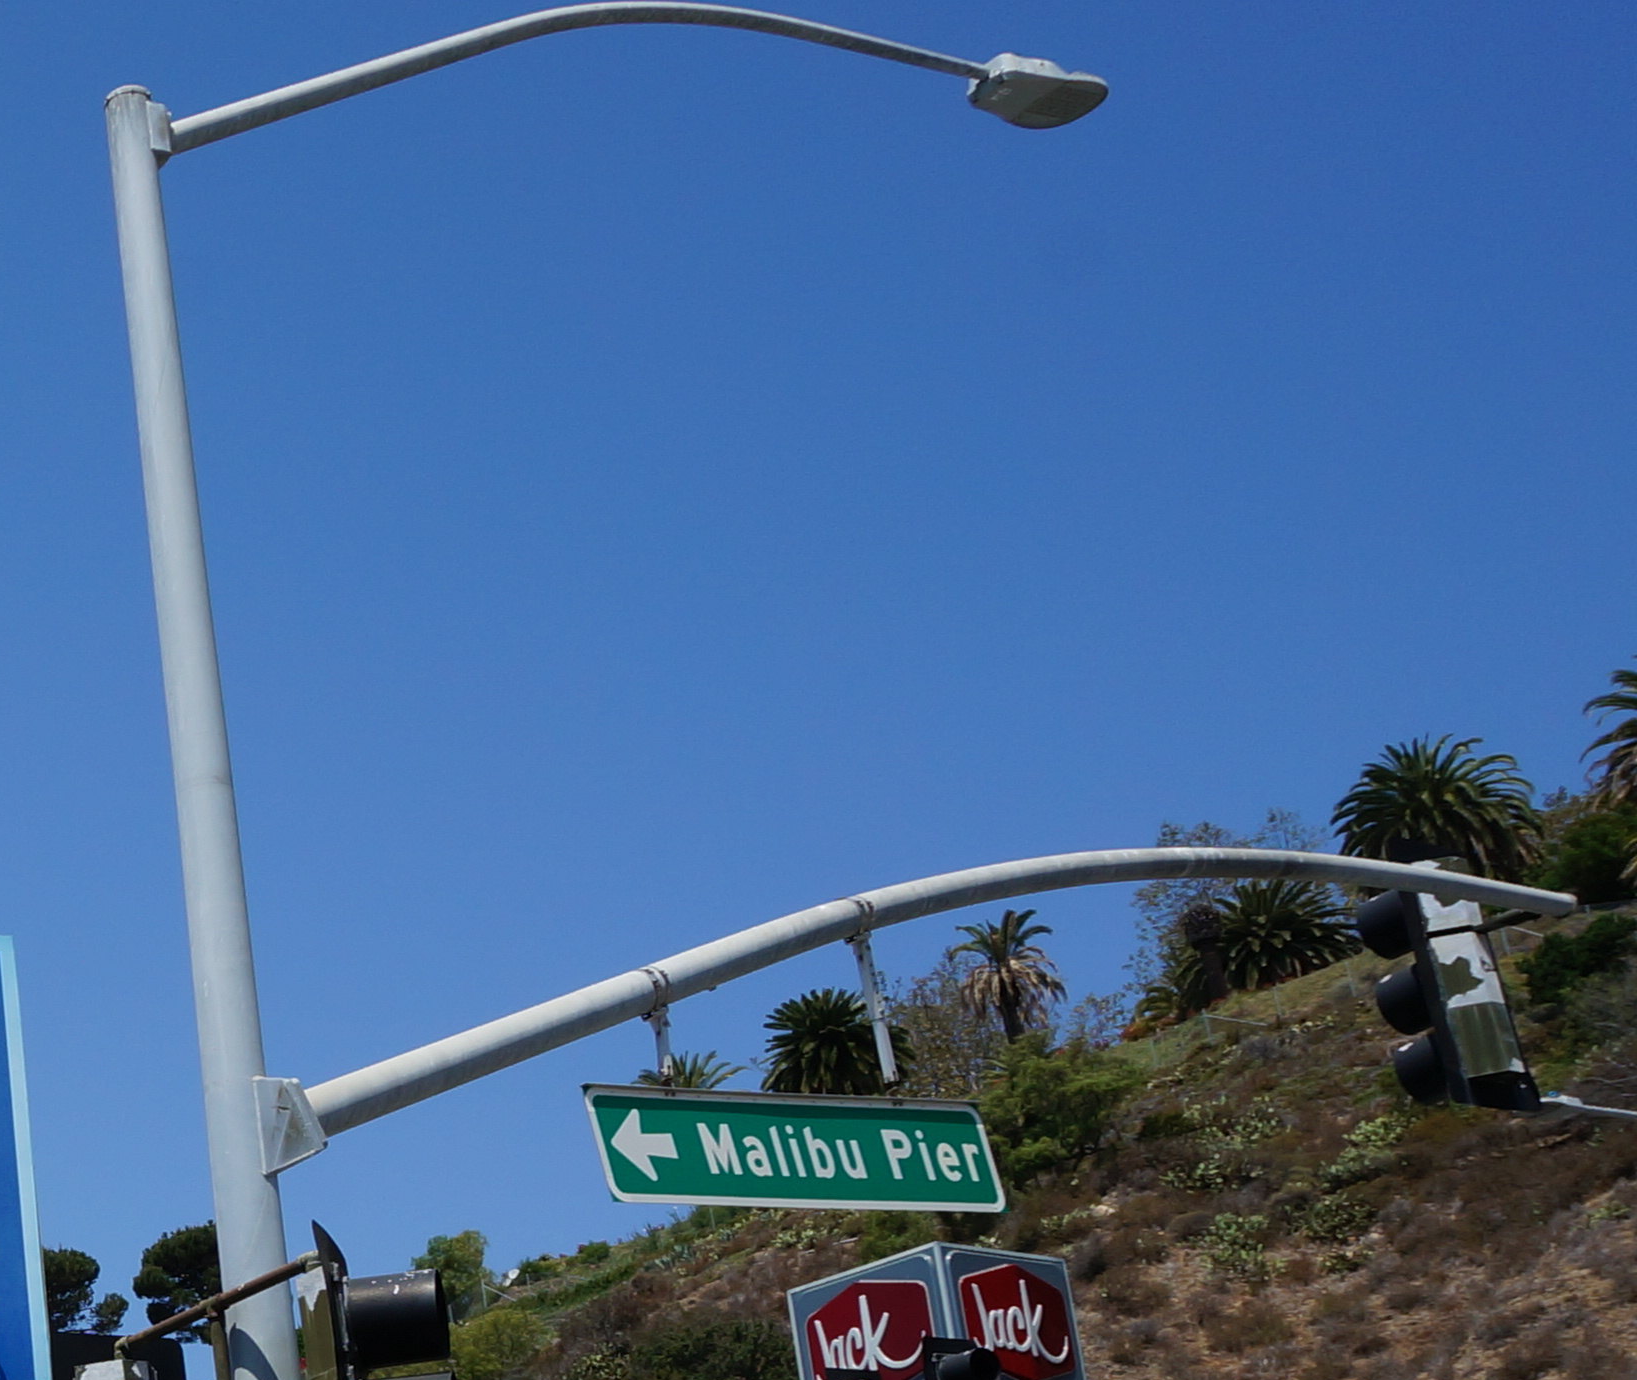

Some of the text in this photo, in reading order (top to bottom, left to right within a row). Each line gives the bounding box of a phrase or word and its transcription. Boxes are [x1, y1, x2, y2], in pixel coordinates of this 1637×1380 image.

[696, 1122, 980, 1183] Malibu Pier
[971, 1279, 1069, 1364] Jack
